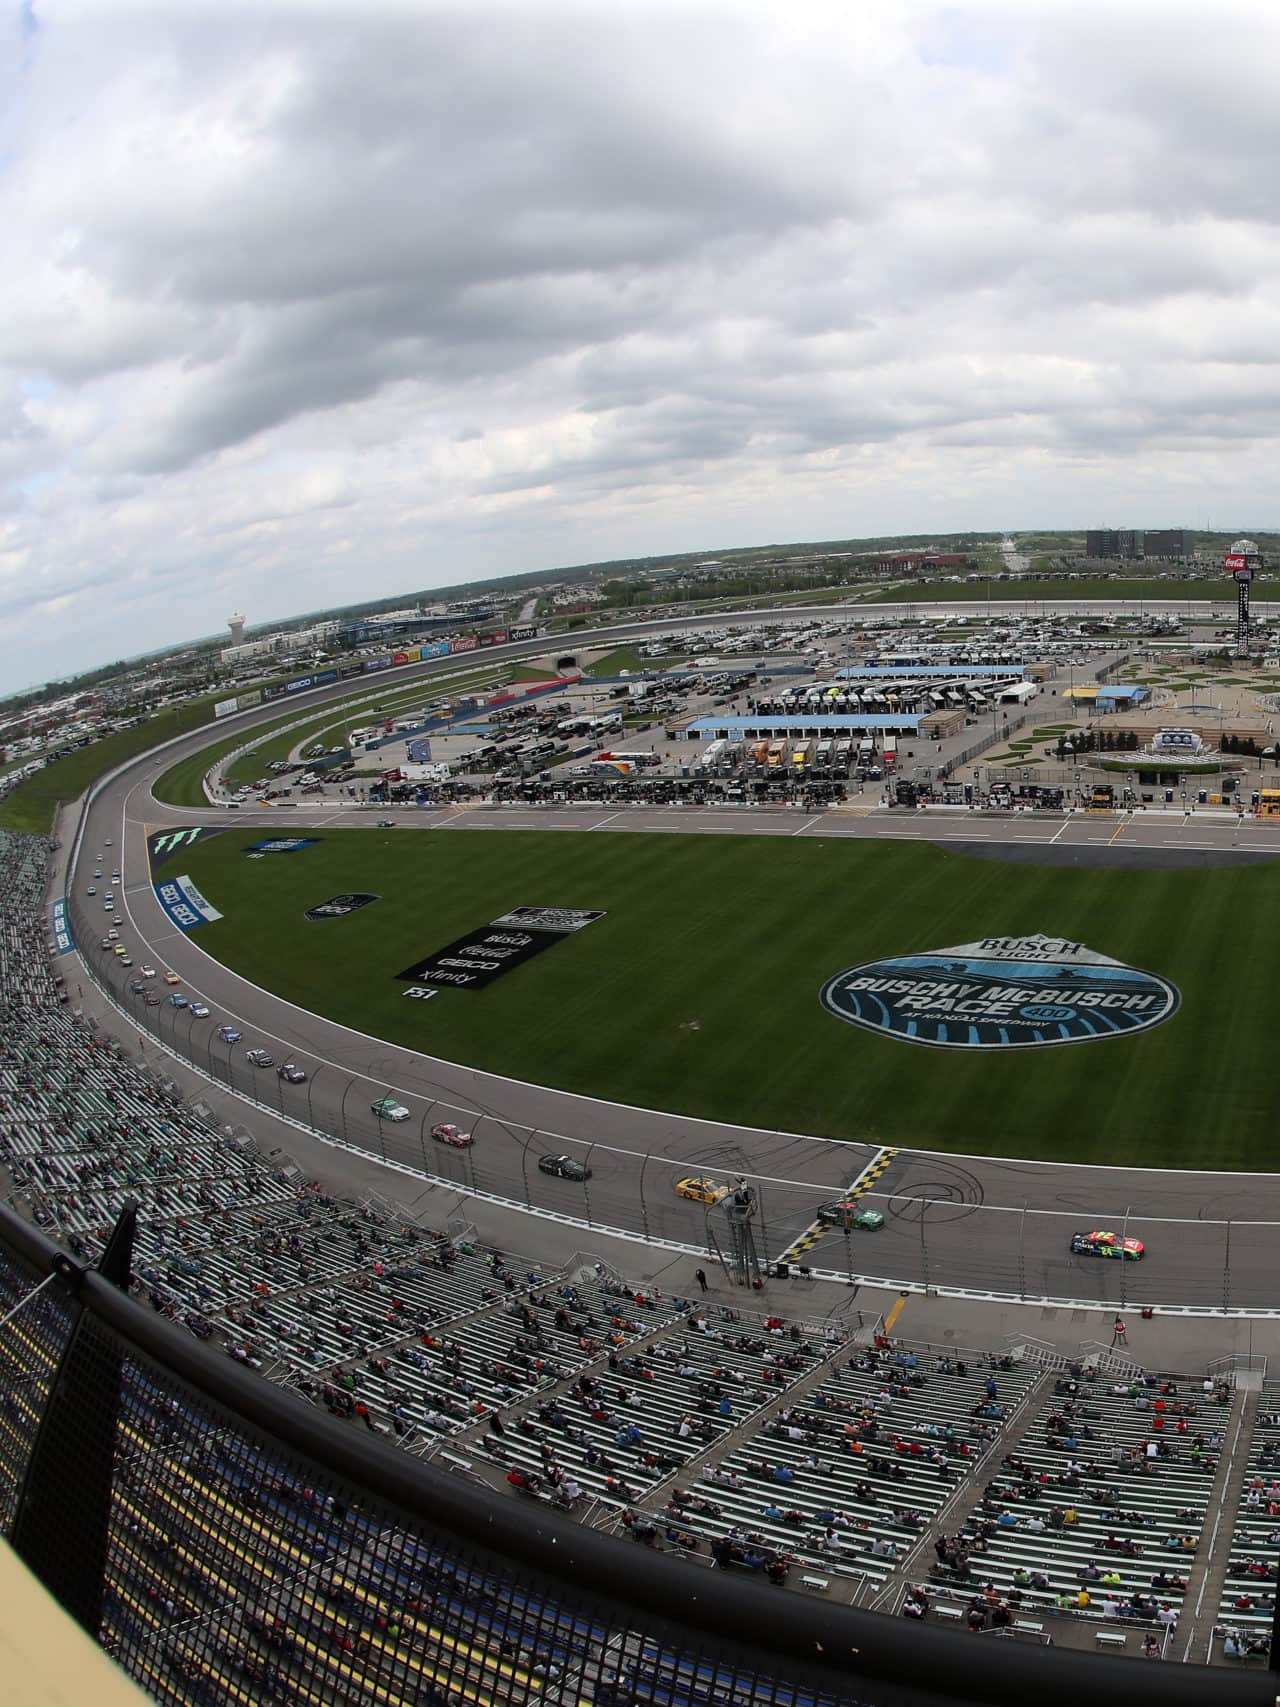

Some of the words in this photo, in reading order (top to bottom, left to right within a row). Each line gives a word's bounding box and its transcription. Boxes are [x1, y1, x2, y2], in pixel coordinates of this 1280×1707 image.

[511, 628, 535, 641] xfinity
[287, 678, 311, 691] GEICO
[484, 934, 533, 946] BUSCH
[979, 939, 1081, 954] BUSCH
[996, 951, 1054, 960] LIGHT
[437, 958, 500, 970] GEICO
[419, 970, 478, 985] xfinity
[402, 986, 439, 999] FS1
[844, 977, 984, 999] BUSCHY
[893, 995, 1021, 1015] RACE
[1025, 1008, 1072, 1019] 400
[921, 1013, 979, 1023] KANSAS
[977, 1017, 1052, 1028] SPEEDWAY
